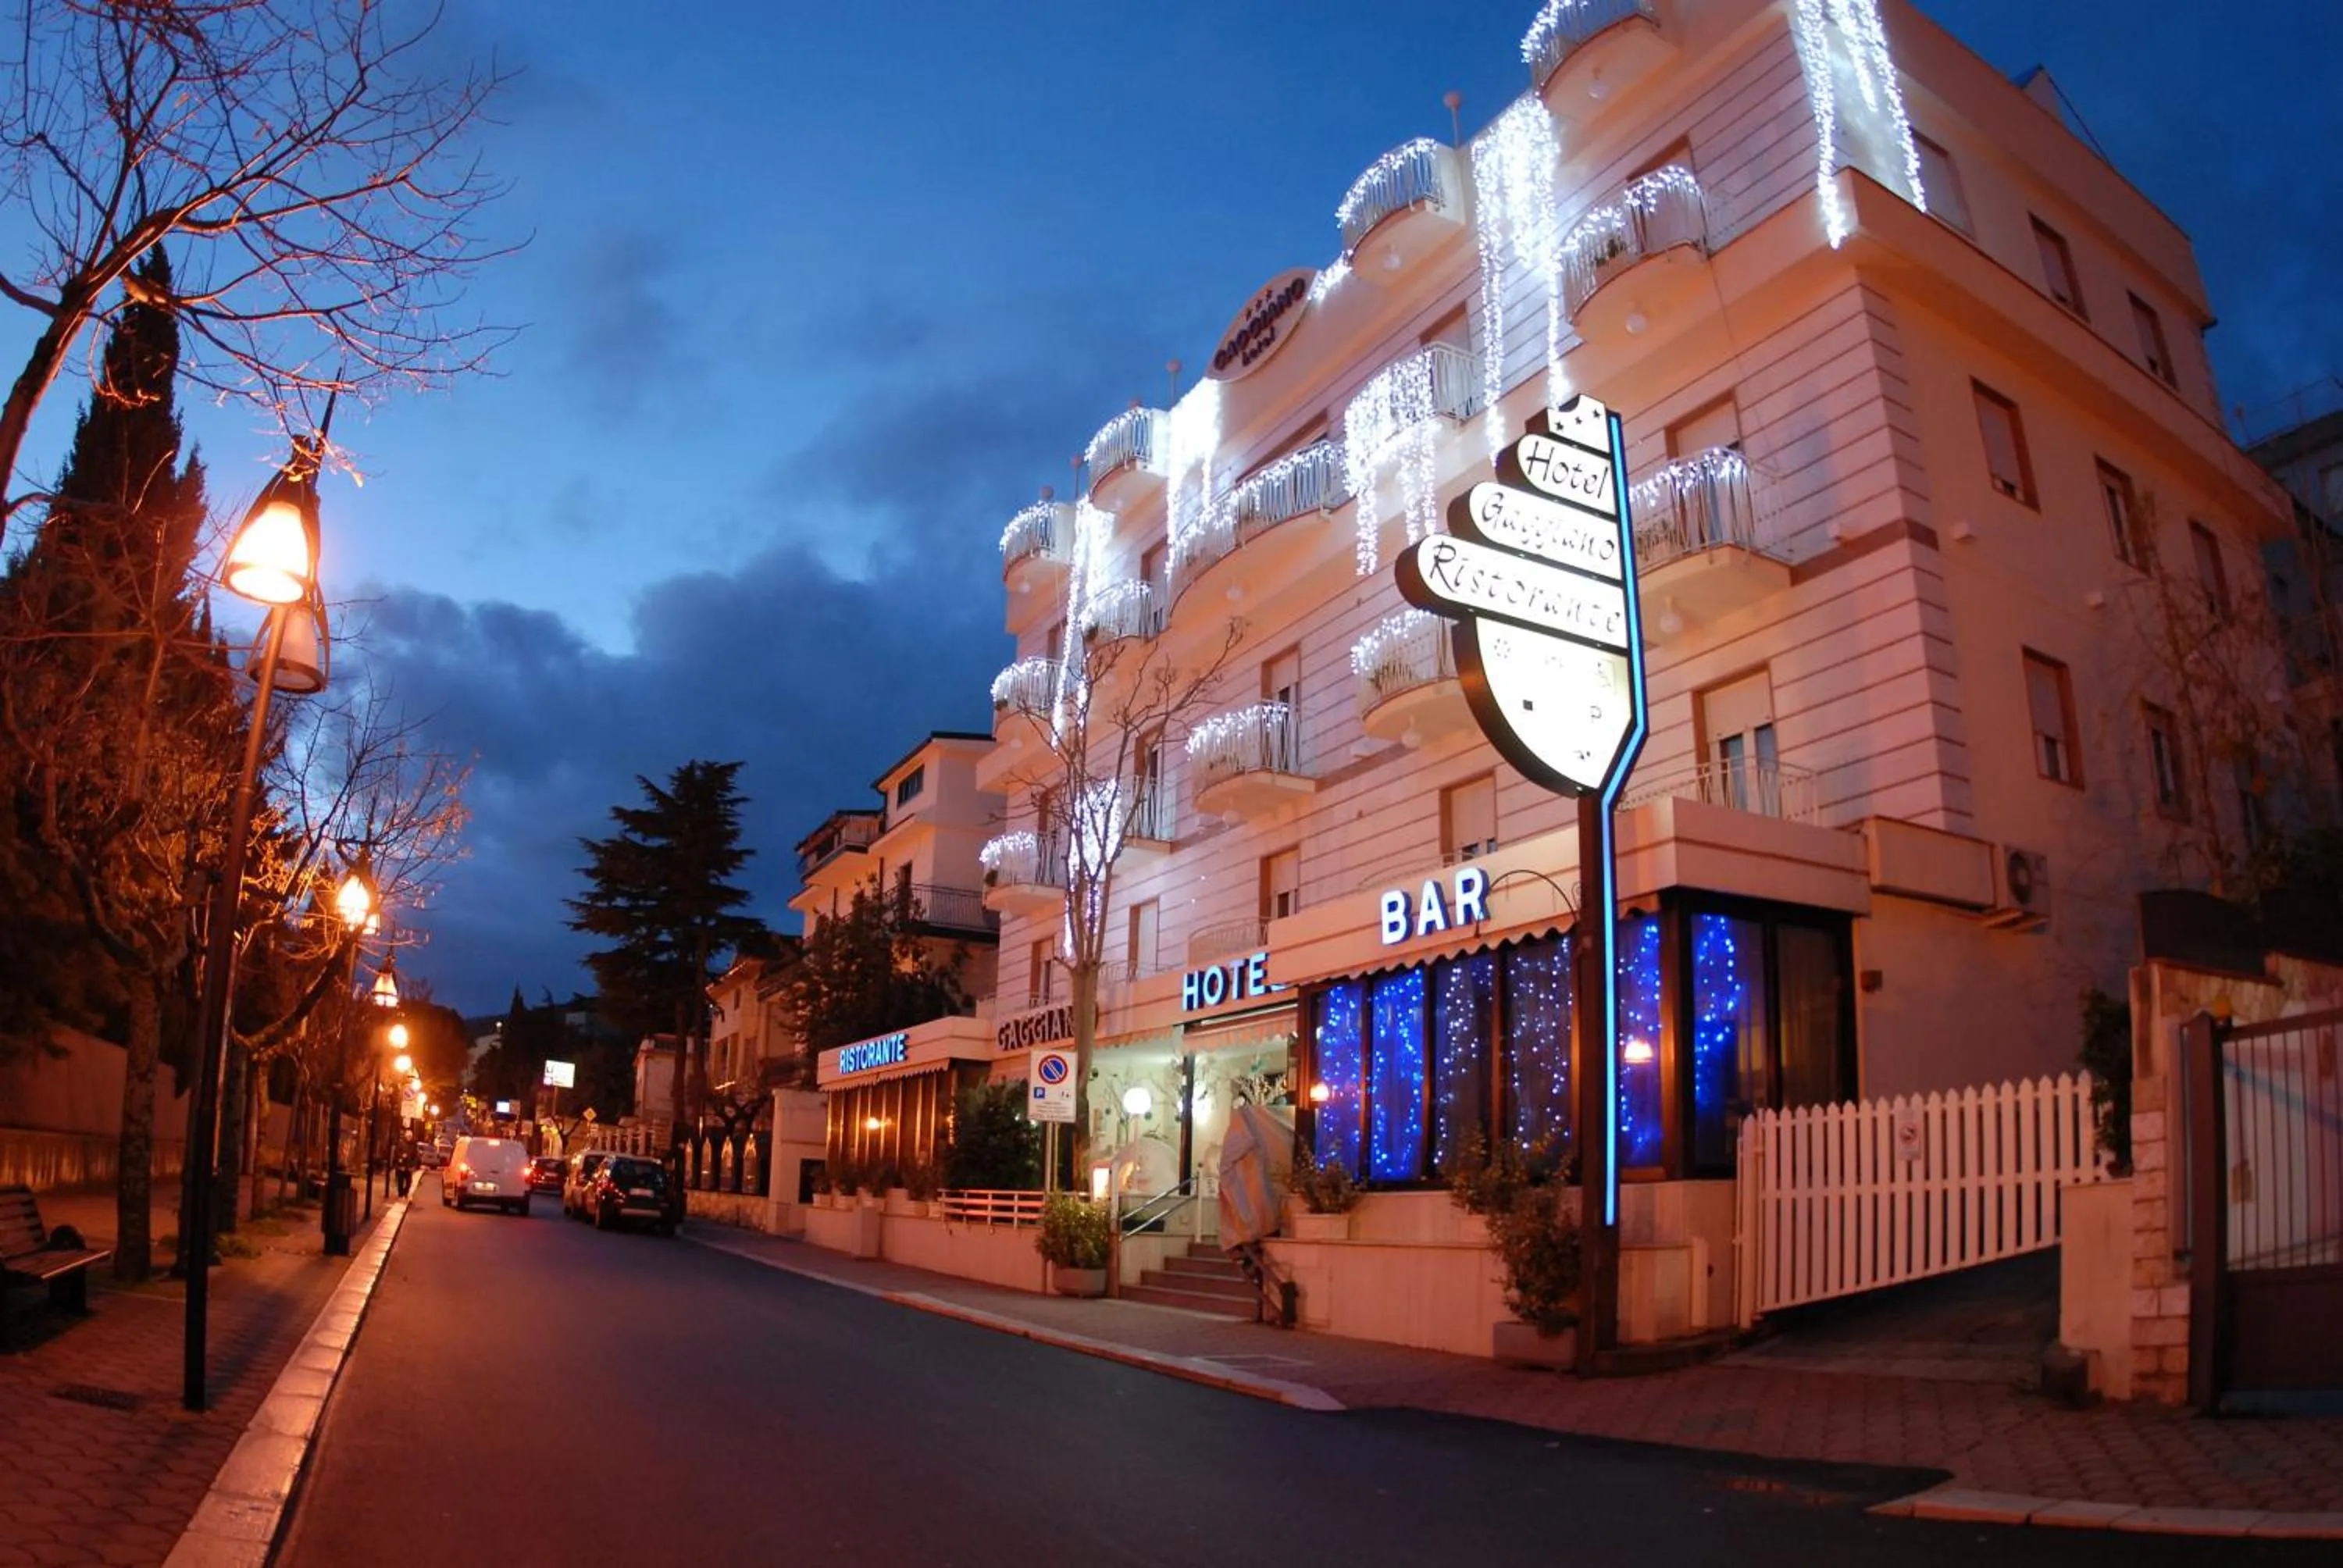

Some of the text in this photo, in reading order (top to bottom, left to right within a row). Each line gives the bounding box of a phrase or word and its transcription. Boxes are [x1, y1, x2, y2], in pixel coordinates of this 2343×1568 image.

[1525, 440, 1609, 499] Hotel
[1481, 491, 1615, 561] Gaggiano
[1428, 540, 1621, 633] Ristorante
[1380, 866, 1486, 945] BAR
[1181, 951, 1289, 1012] HOTE
[839, 1032, 908, 1075] RISTORANTE
[997, 1003, 1099, 1051] GAGGIAN
